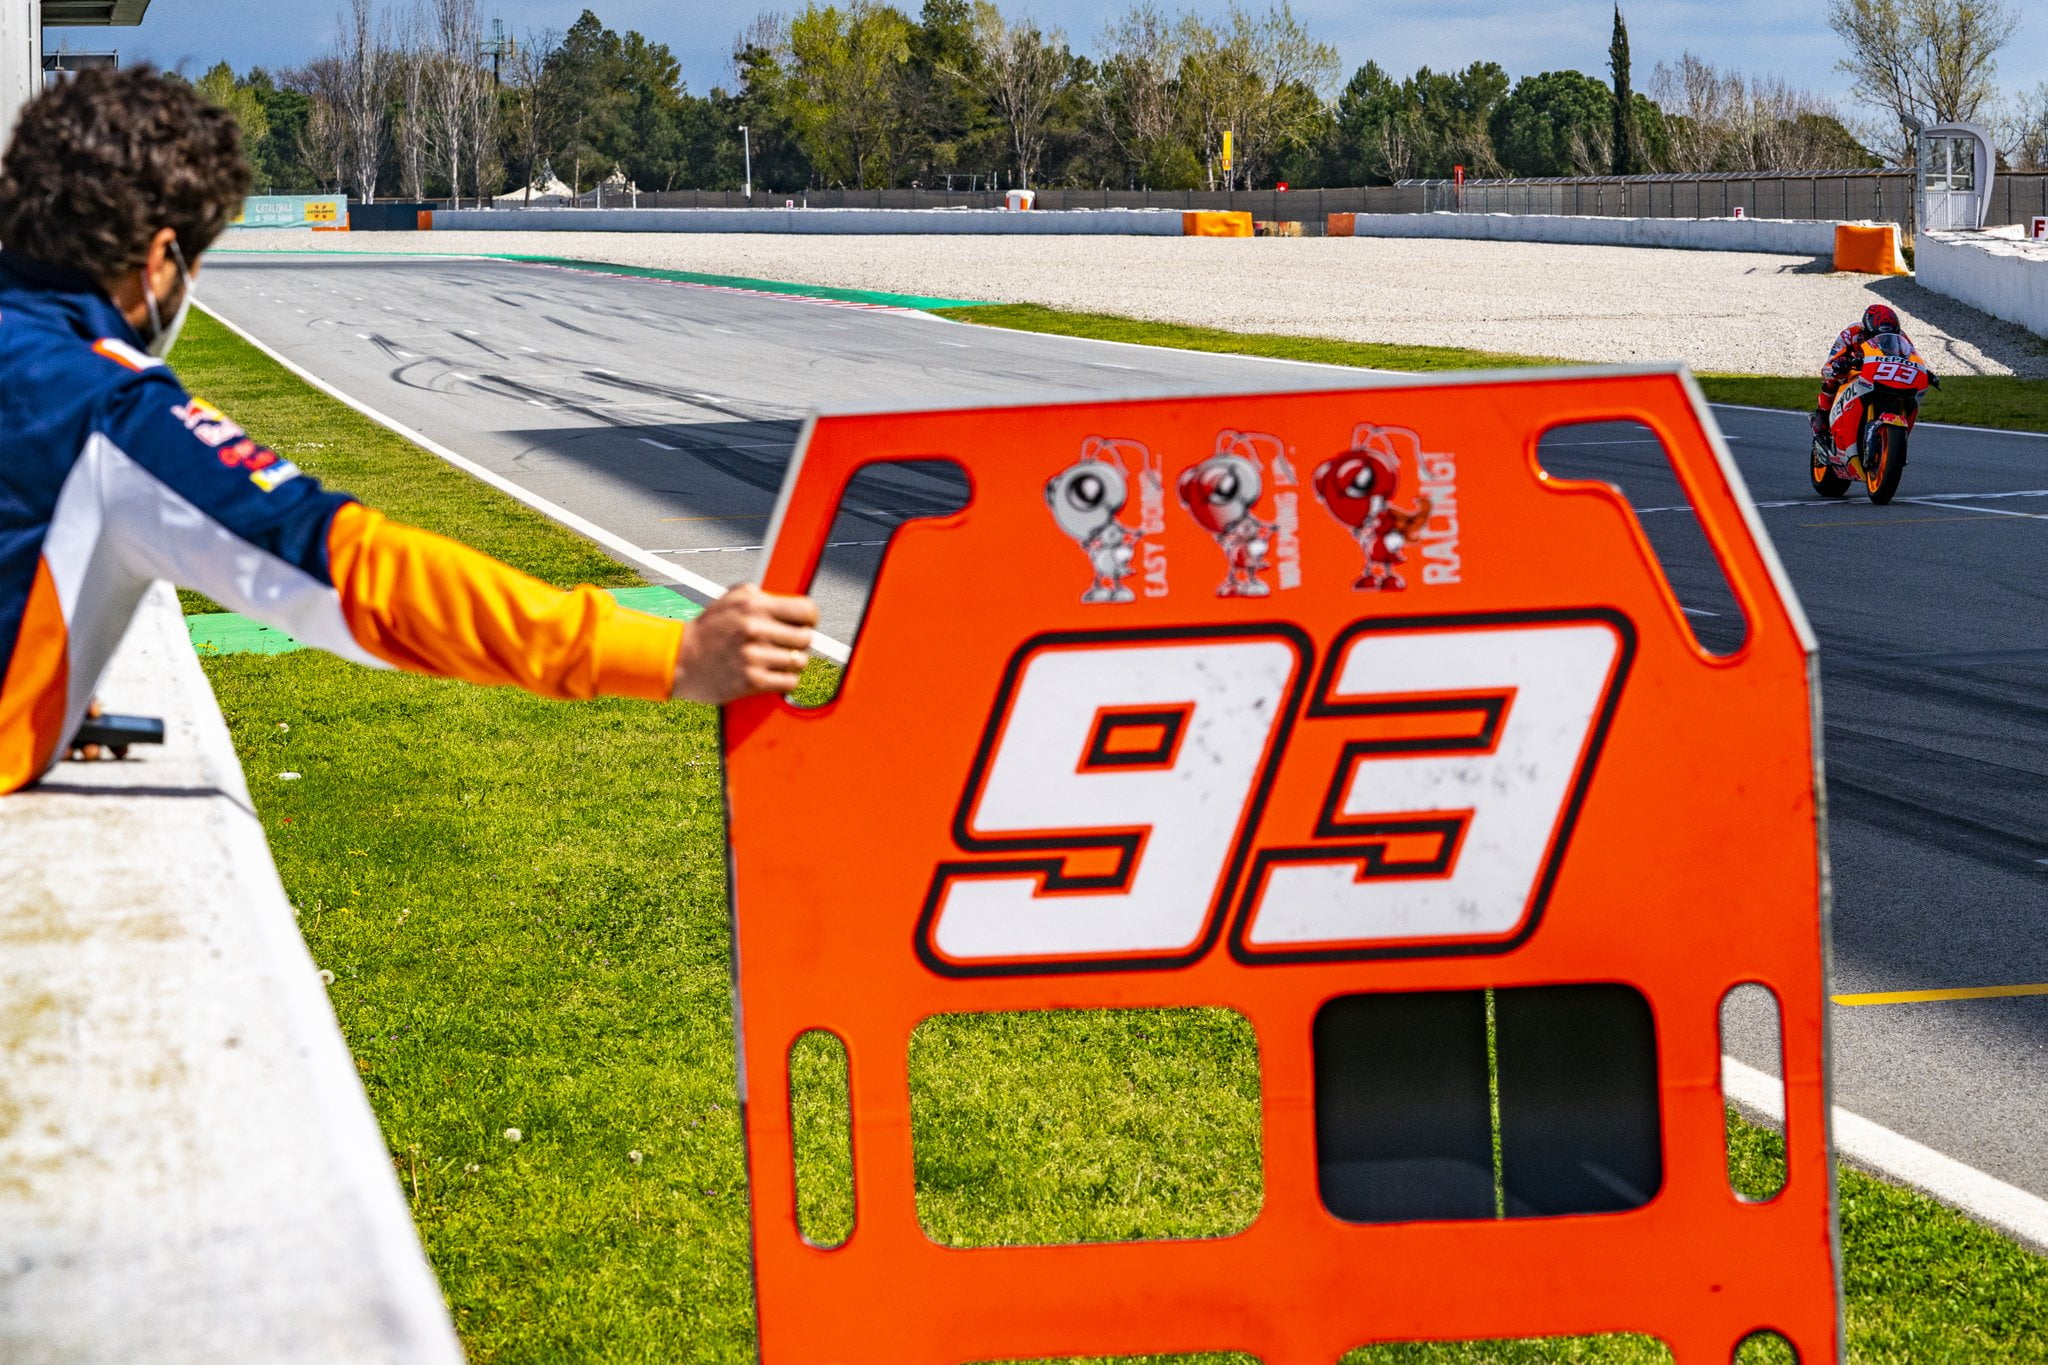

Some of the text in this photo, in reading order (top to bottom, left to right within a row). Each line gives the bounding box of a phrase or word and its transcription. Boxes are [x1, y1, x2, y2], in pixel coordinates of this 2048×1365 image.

[1735, 208, 1742, 218] F
[2034, 219, 2046, 238] F
[1873, 363, 1918, 385] 93
[1143, 541, 1168, 598] EASY
[914, 608, 1637, 978] 93
